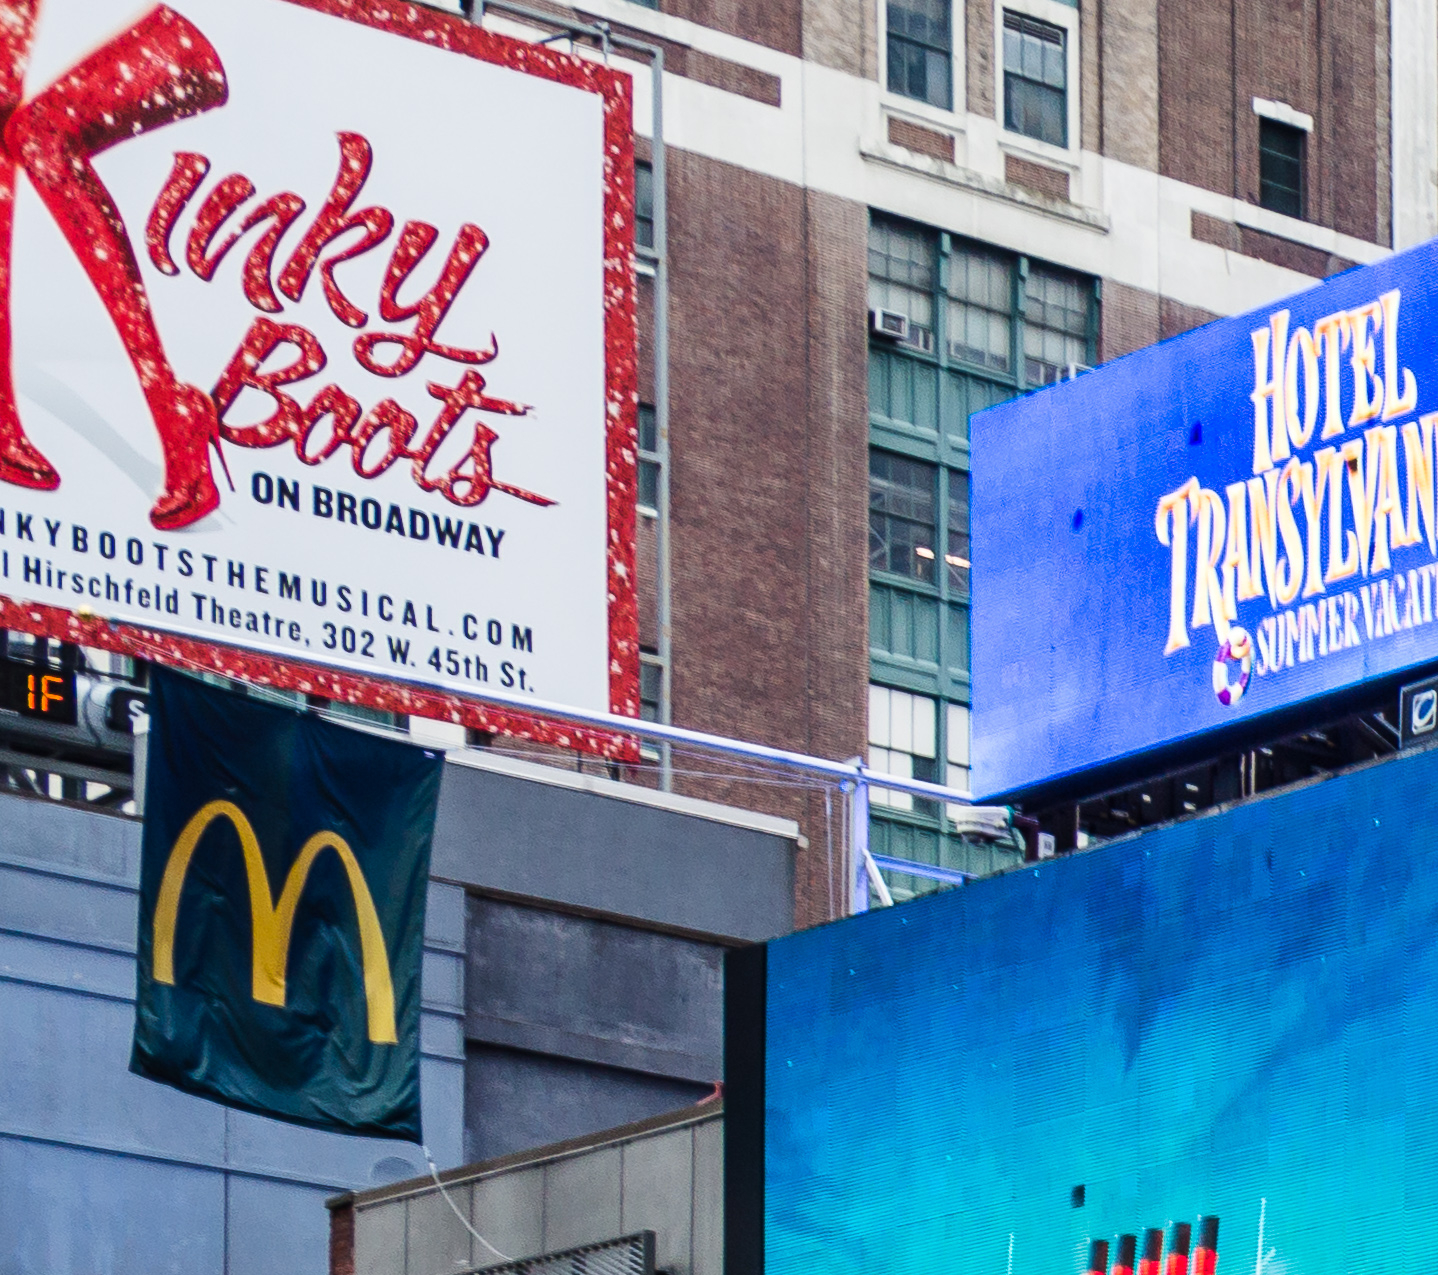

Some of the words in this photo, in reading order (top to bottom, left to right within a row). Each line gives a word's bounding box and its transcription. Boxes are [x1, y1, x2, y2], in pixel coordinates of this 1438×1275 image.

[211, 316, 560, 507] Boots
[1250, 289, 1416, 471] HOTEL
[252, 472, 300, 512] ON
[312, 485, 505, 559] BROADWAY
[23, 554, 179, 615] Hirschfeld
[192, 591, 310, 647] Theatre,
[322, 621, 375, 659] 302
[388, 634, 416, 667] W.
[428, 646, 488, 682] 45th
[501, 661, 534, 693] St.
[1255, 591, 1360, 676] SUMMER
